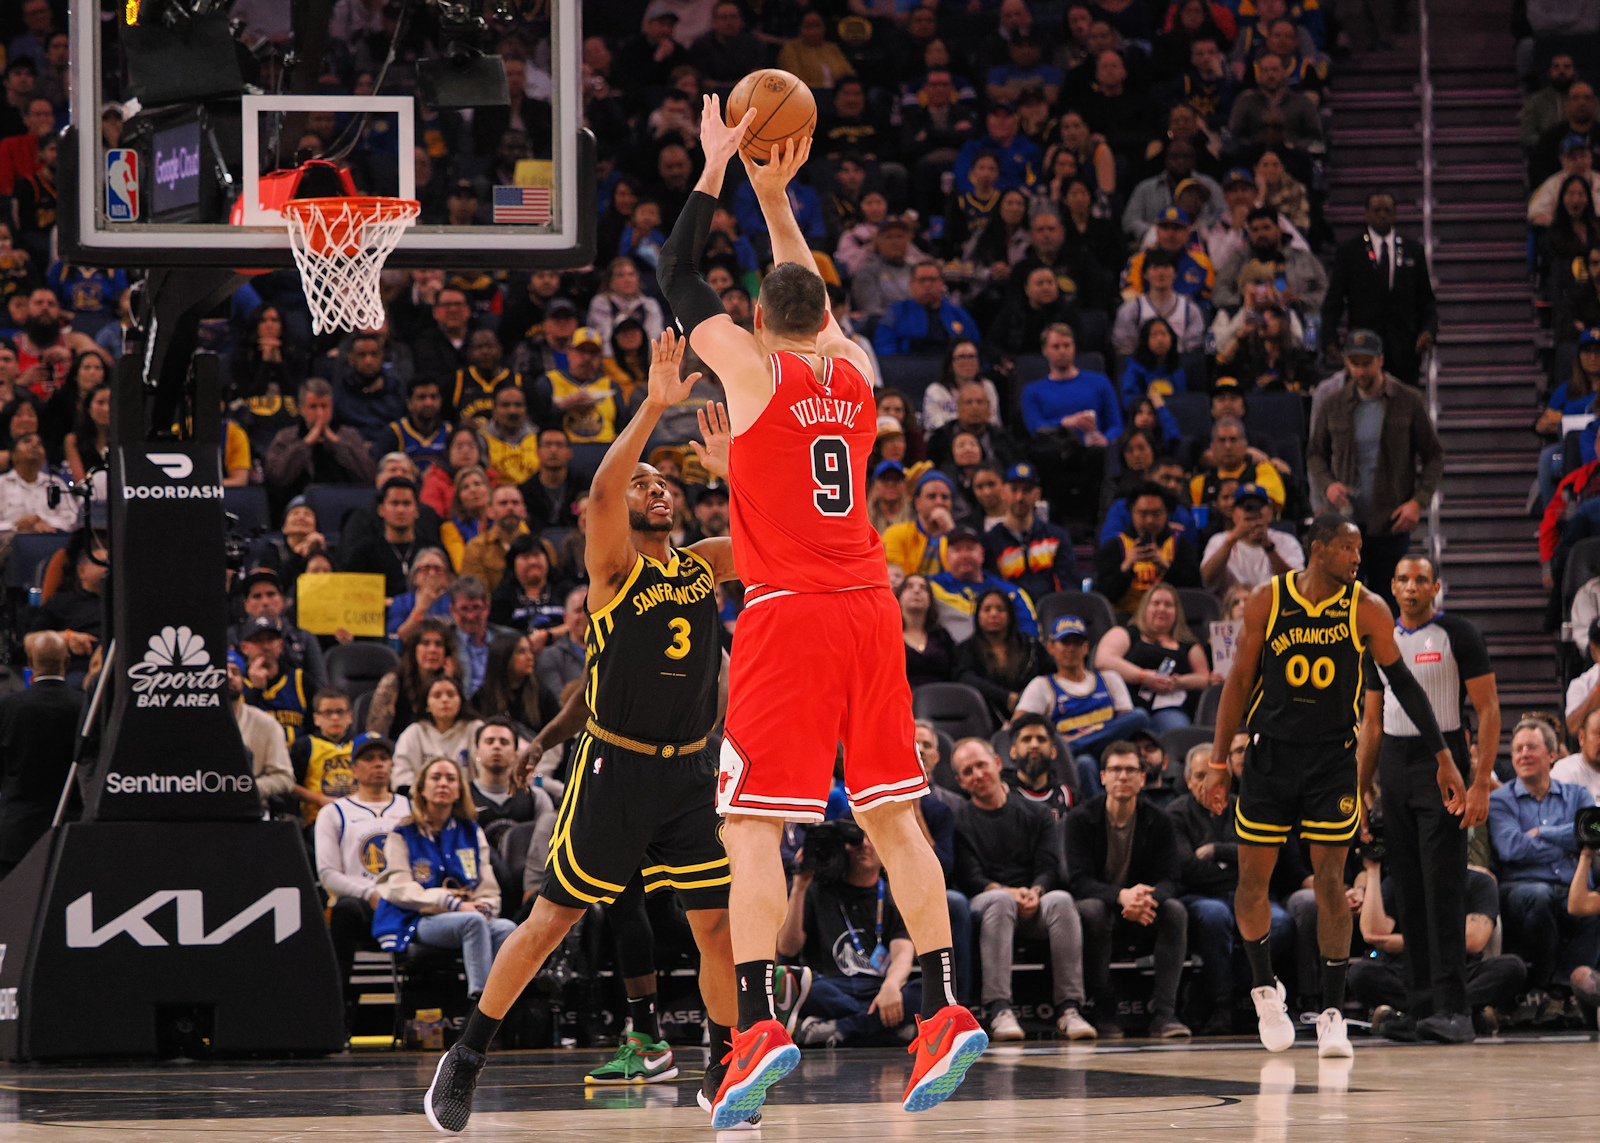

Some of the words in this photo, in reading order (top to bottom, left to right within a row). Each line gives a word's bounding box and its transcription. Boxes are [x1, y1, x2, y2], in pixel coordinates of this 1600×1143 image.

[123, 485, 225, 499] DOORDASH
[810, 435, 854, 516] 9
[663, 617, 692, 660] 3
[1270, 632, 1292, 656] SAN
[1288, 622, 1350, 645] FRANCISCO
[127, 661, 227, 697] Sports
[1285, 654, 1336, 689] 00
[136, 693, 171, 708] BAY
[172, 693, 220, 708] AREA
[106, 769, 253, 794] SentinelOne
[65, 886, 301, 948] KIA
